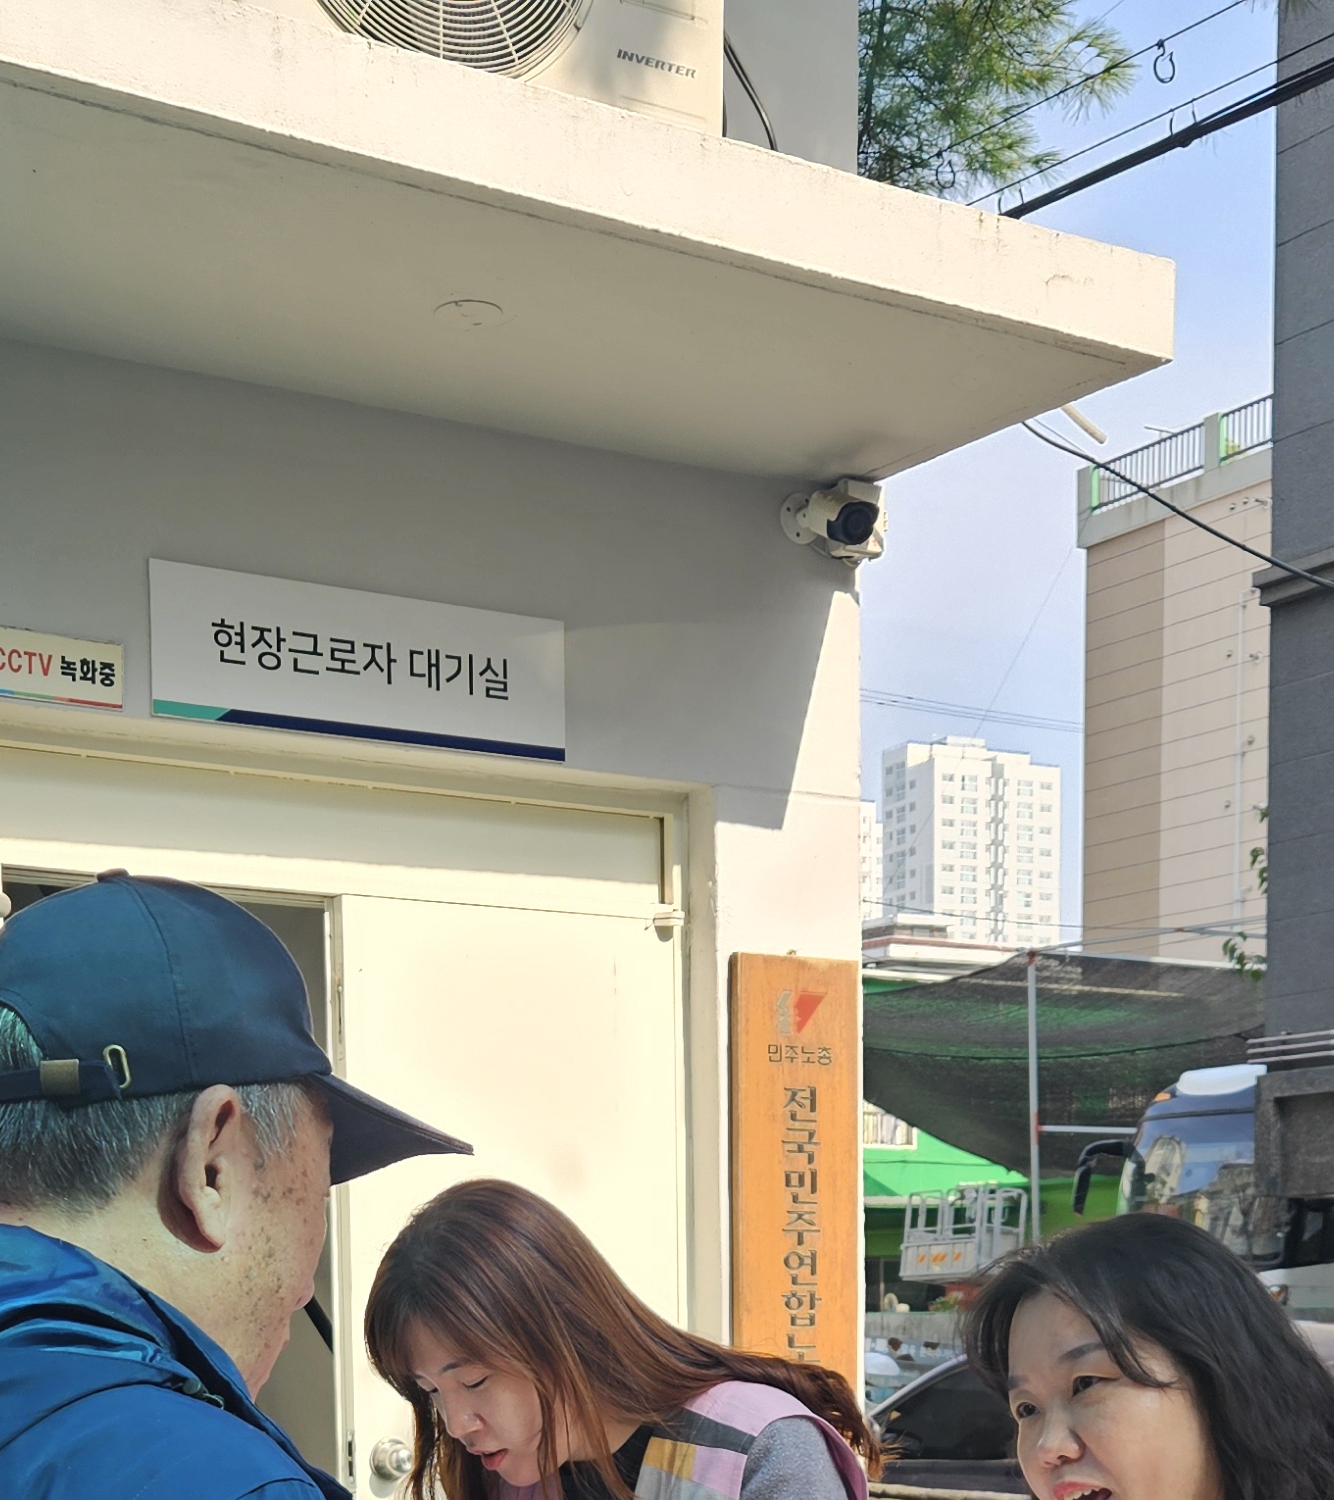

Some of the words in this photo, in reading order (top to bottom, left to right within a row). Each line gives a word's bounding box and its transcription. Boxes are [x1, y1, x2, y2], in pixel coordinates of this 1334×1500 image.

[616, 47, 697, 79] INVERTER
[59, 654, 117, 687] 녹화중
[210, 616, 398, 688] 현장근로자
[407, 648, 510, 701] 대기실
[767, 1043, 834, 1066] 민주노총
